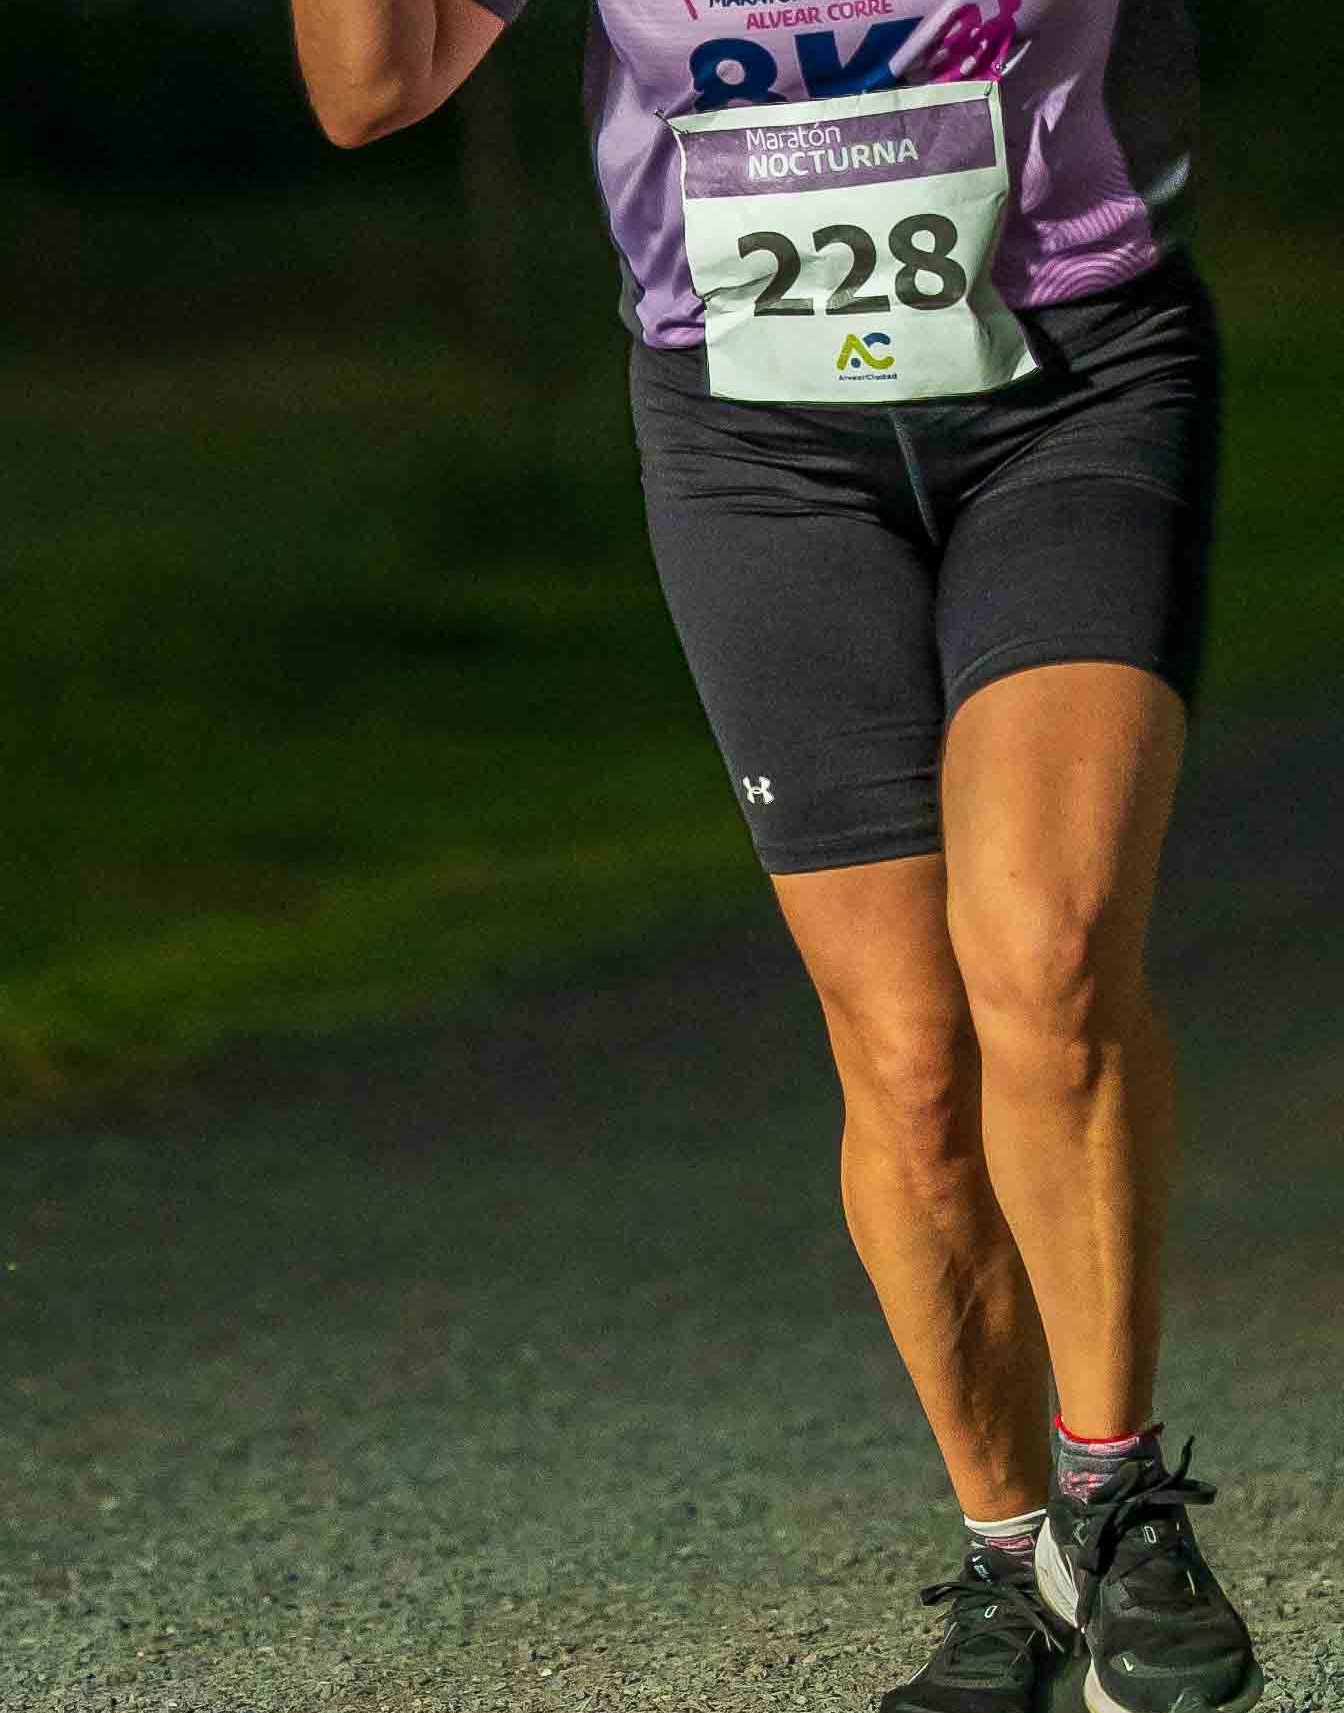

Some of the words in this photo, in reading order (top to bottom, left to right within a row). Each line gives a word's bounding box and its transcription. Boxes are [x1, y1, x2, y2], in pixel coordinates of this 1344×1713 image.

[746, 6, 822, 31] ALVEAR
[746, 119, 841, 151] Maratón
[748, 138, 919, 179] NOCTURNA
[737, 213, 967, 317] 228
